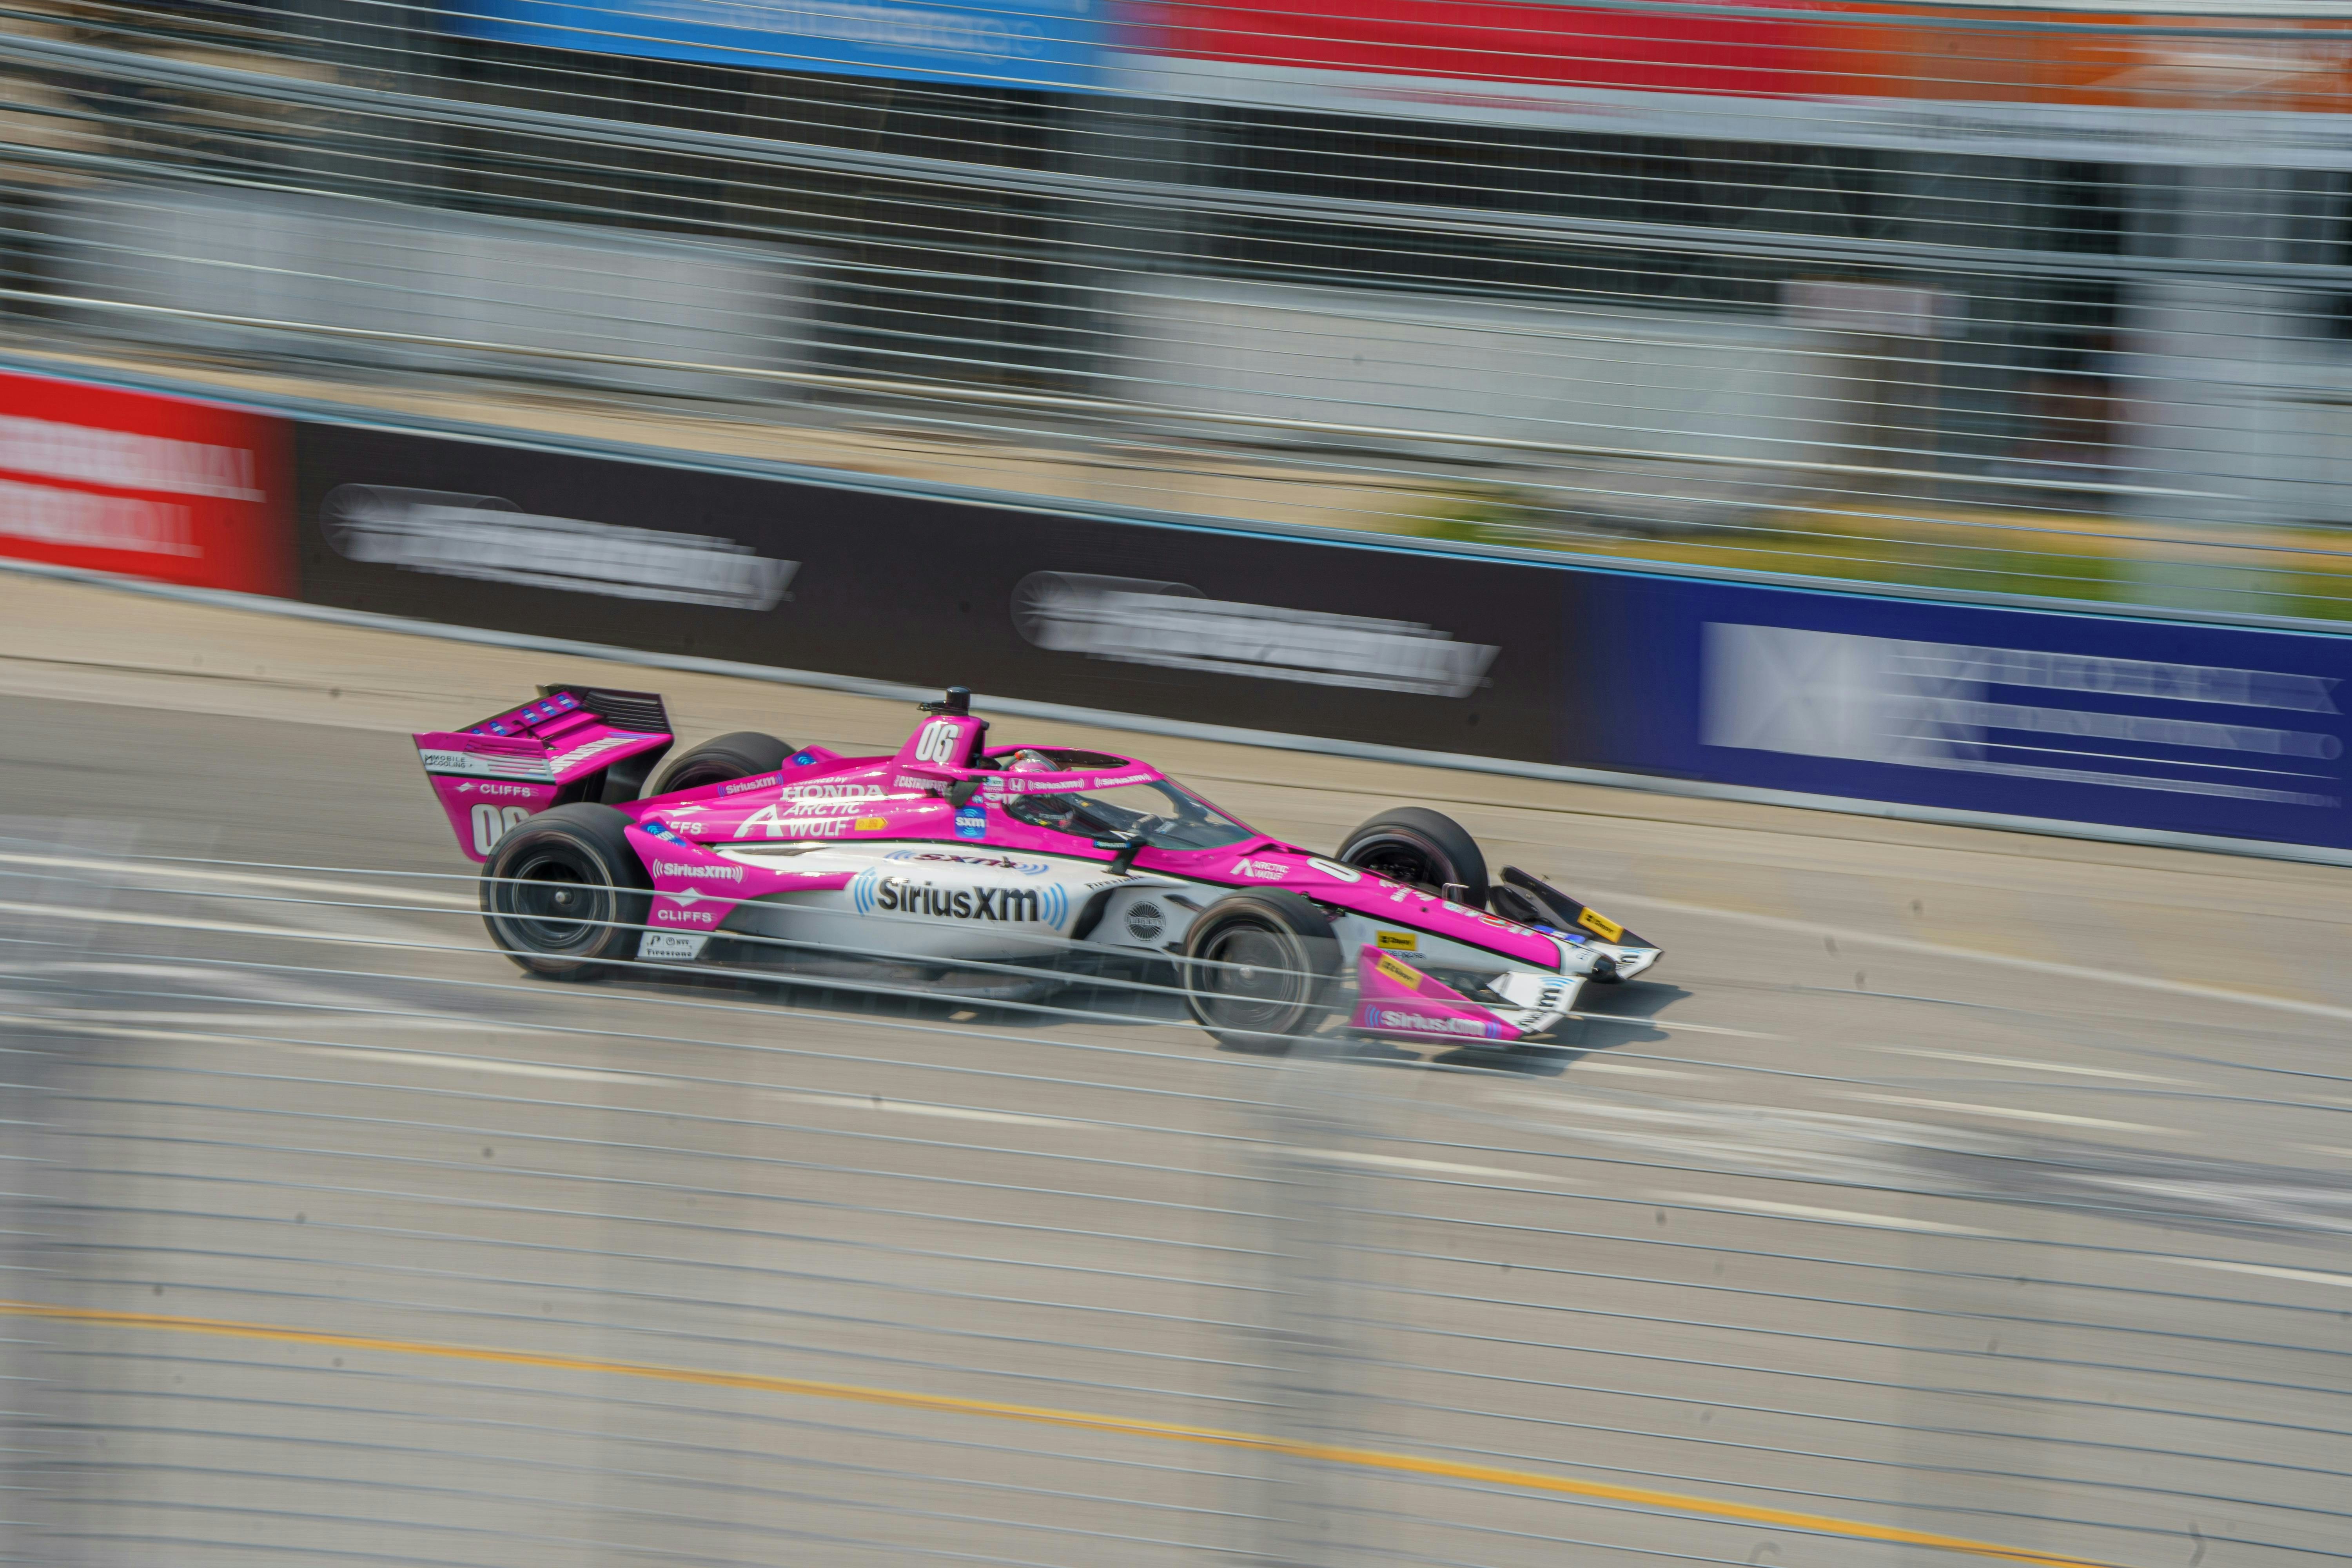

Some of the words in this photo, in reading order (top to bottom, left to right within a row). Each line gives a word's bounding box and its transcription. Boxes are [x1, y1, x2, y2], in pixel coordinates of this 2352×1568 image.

[915, 722, 959, 762] 06
[480, 784, 531, 797] CLIFFS
[780, 784, 884, 800] HONDA
[783, 802, 860, 815] ARCTIC
[789, 818, 848, 837] WOLF
[658, 909, 712, 923] CLIFFS
[646, 948, 692, 956] Firestone
